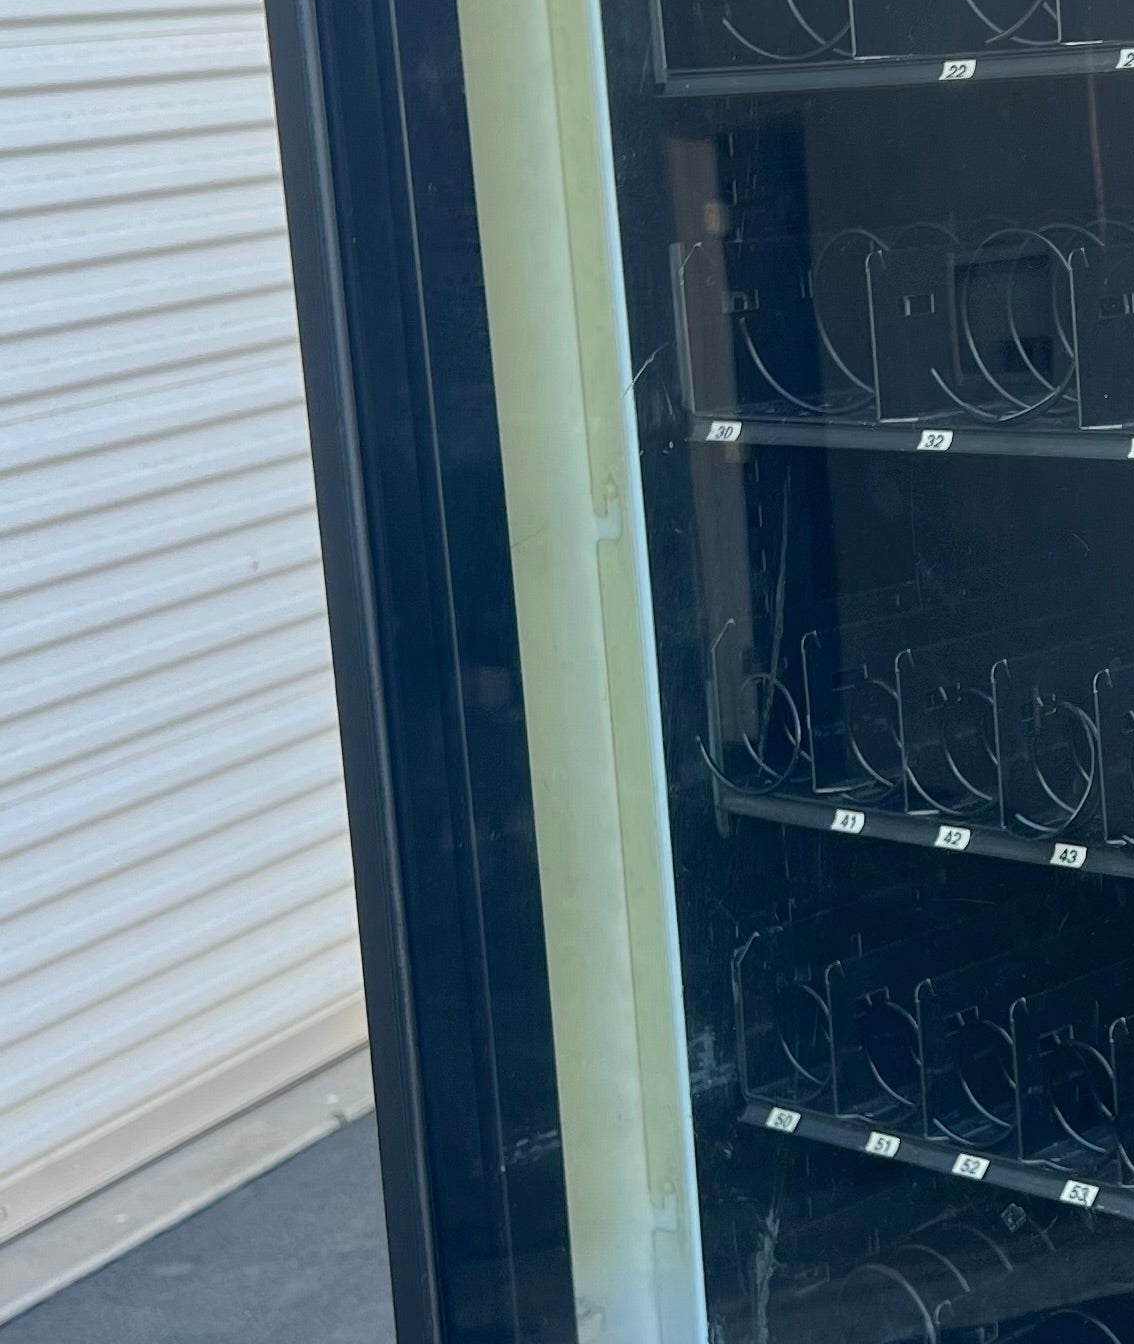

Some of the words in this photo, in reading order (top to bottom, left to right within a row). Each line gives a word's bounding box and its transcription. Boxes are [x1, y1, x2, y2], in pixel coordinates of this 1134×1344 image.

[948, 64, 968, 78] 22
[716, 426, 734, 439] 30
[927, 434, 945, 448] 32
[943, 833, 962, 847] 42
[1059, 849, 1078, 863] 43
[776, 1113, 793, 1127] 50
[960, 1159, 981, 1174] 52
[1069, 1184, 1088, 1202] 53
